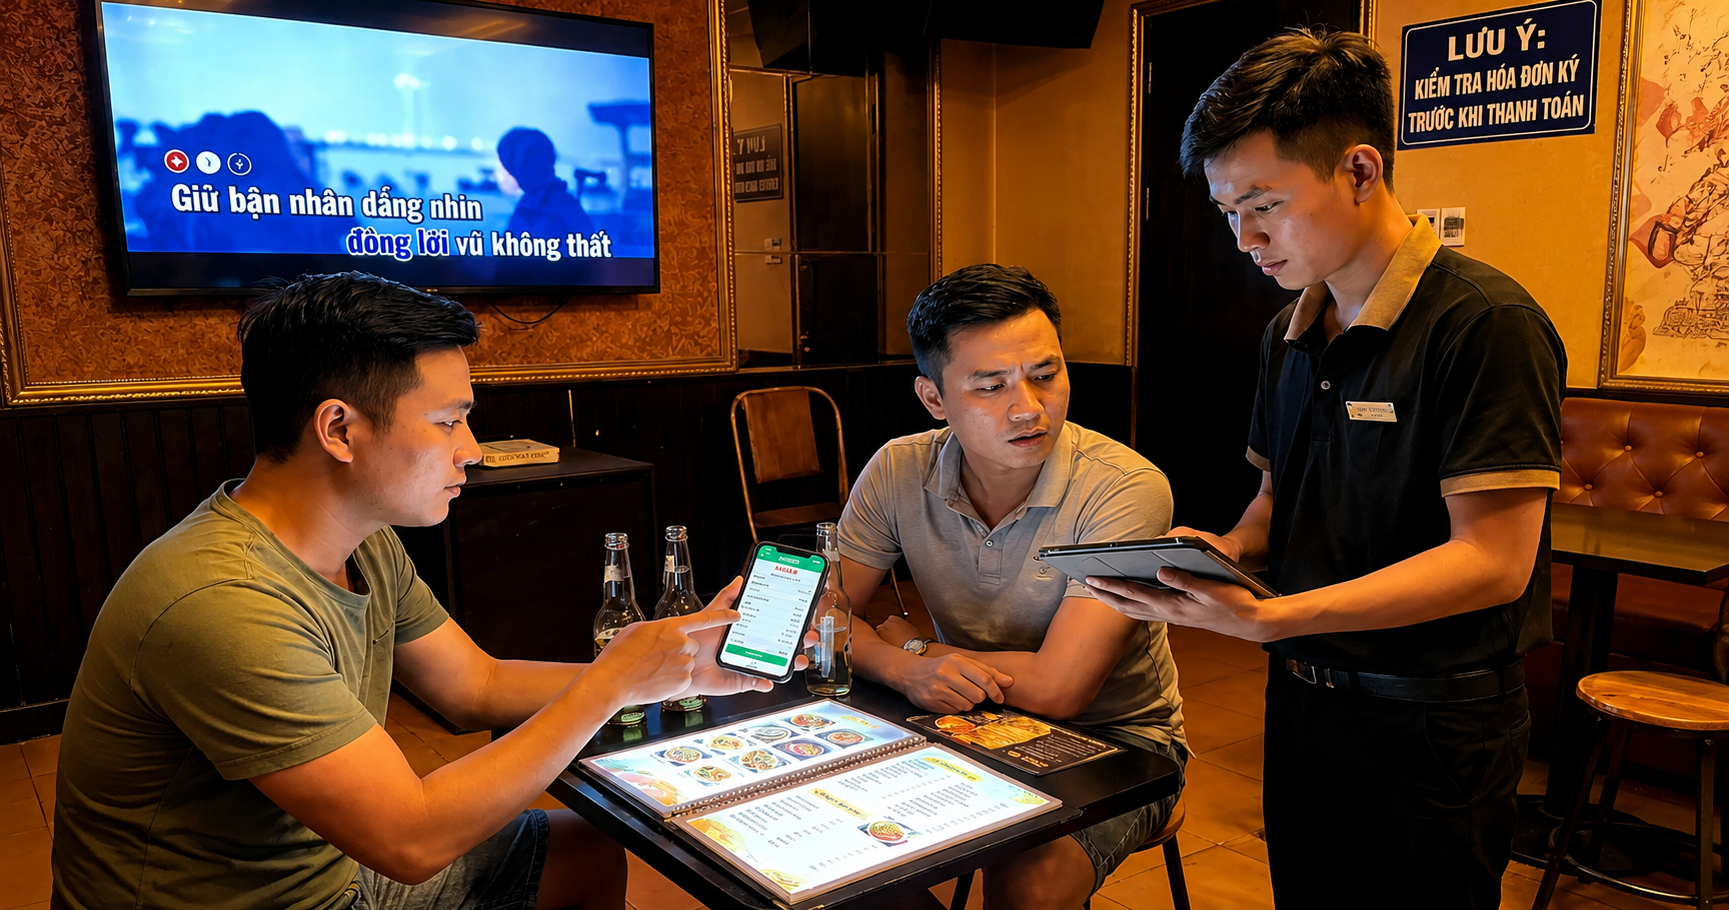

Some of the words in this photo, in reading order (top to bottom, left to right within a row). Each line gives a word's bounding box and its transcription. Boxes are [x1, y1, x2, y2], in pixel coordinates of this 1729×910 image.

[1448, 26, 1506, 62] LƯU
[1515, 18, 1546, 52] Ý:
[1414, 66, 1451, 100] KIỂM
[1454, 71, 1482, 96] TRA
[1486, 63, 1516, 92] HÓA
[1520, 60, 1553, 88] ĐƠN
[1557, 53, 1580, 84] KÝ
[1408, 104, 1454, 134] TRƯỚC
[1458, 104, 1483, 128] KHI
[1486, 99, 1538, 126] THANH
[1542, 90, 1585, 120] TOÁN
[228, 185, 281, 220] bận
[289, 188, 354, 216] nhân
[430, 193, 482, 220] nhin
[455, 230, 485, 256] vũ
[491, 231, 561, 261] không
[566, 230, 612, 258] thất
